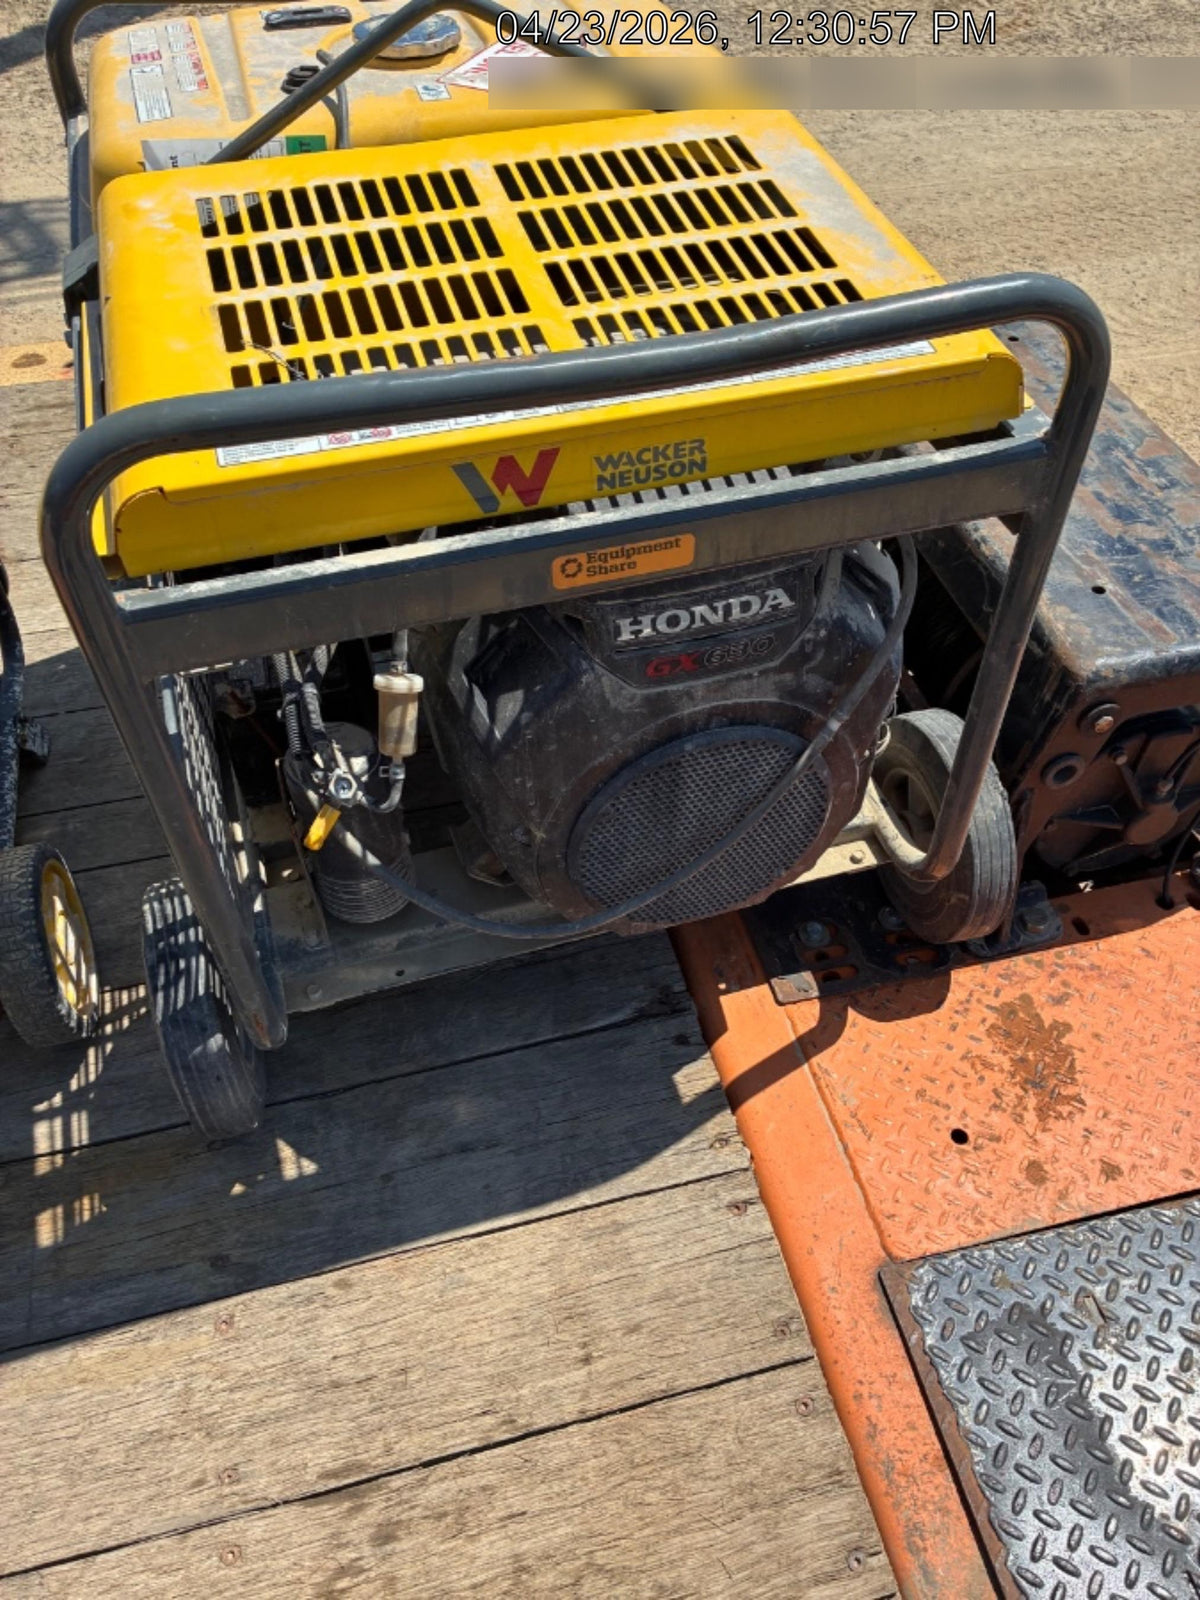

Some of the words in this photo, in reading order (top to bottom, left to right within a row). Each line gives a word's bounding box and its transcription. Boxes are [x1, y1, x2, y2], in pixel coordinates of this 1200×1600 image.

[593, 438, 706, 471] WACKER
[596, 457, 707, 491] NEUSON
[586, 537, 681, 564] Equipment
[586, 559, 638, 578] Share
[615, 587, 796, 643] HONDA
